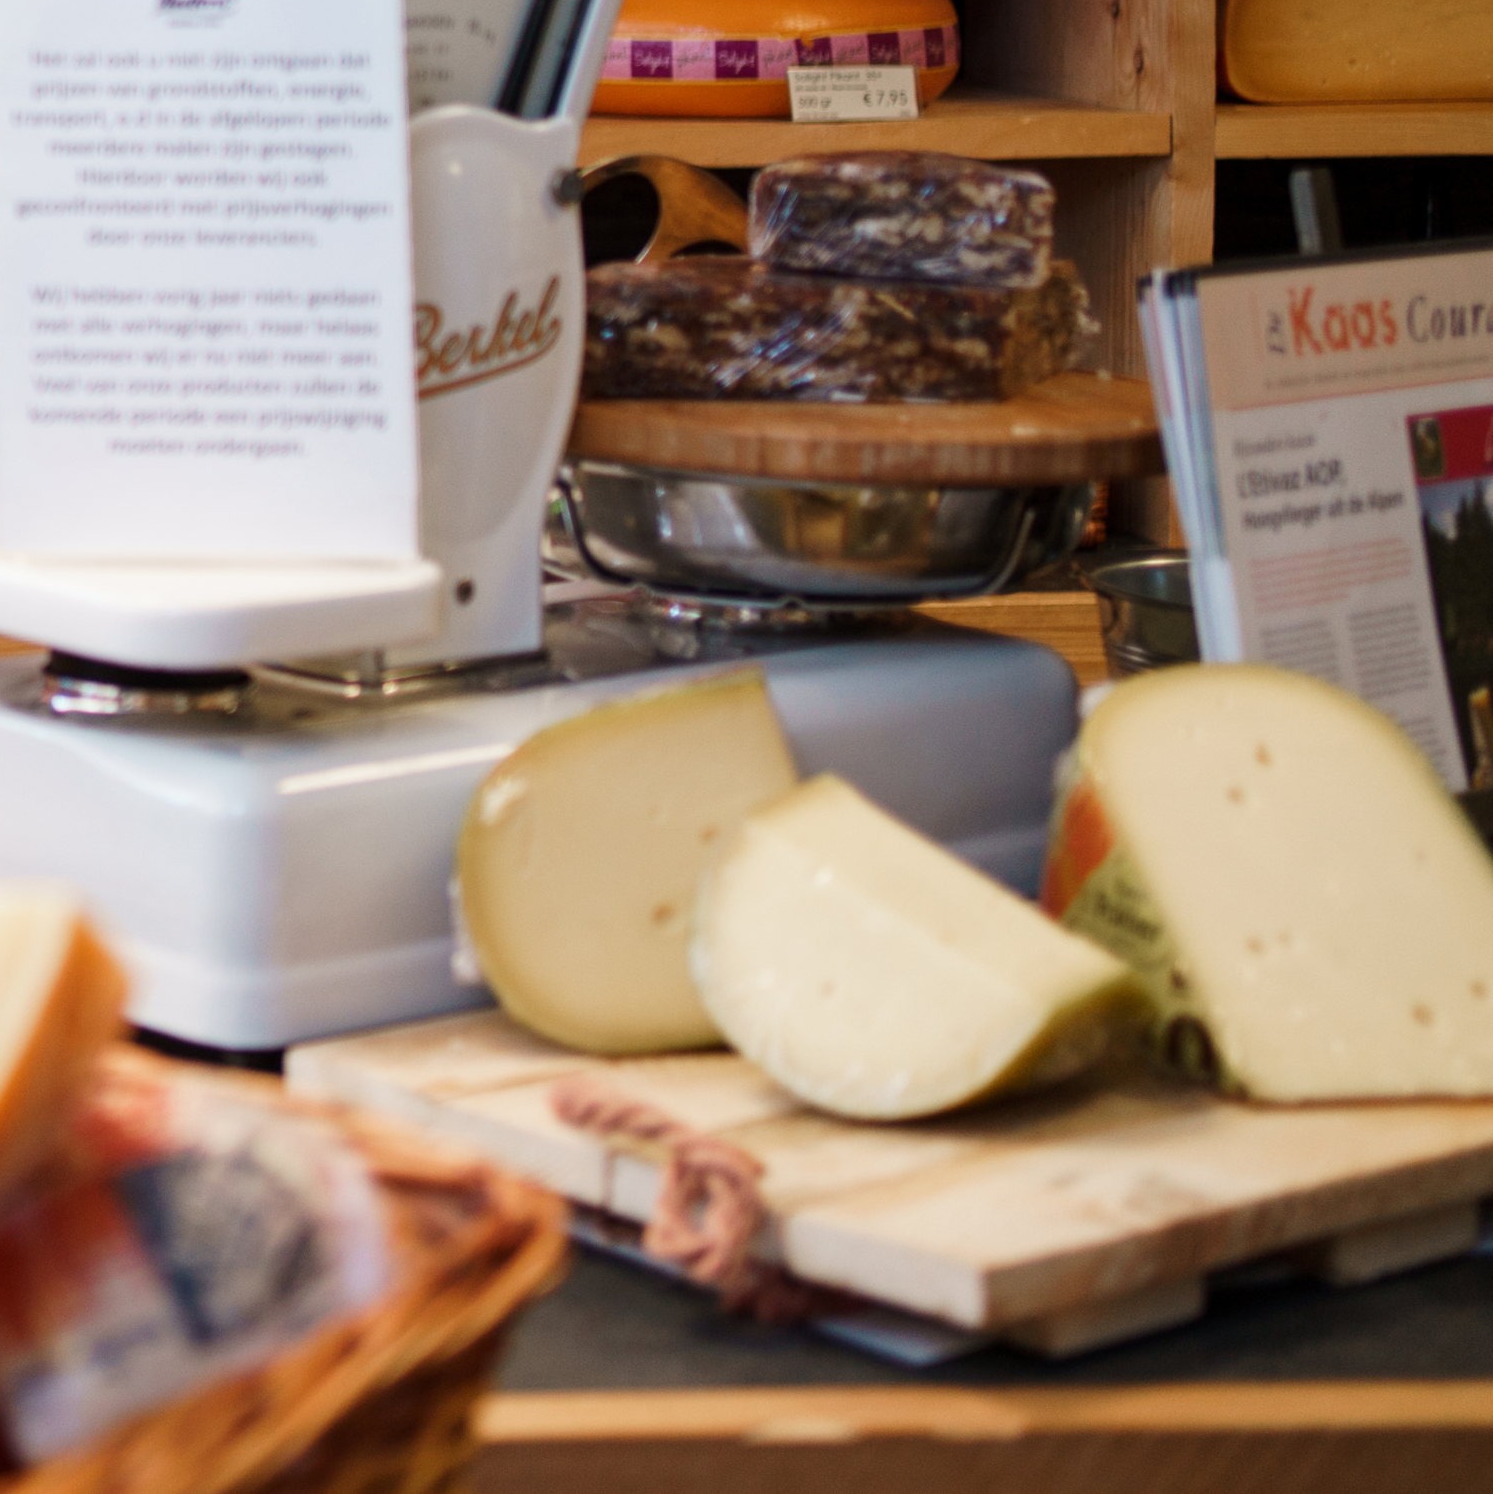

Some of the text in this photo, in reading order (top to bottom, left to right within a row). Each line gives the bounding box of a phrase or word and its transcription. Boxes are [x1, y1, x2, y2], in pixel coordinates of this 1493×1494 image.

[863, 92, 874, 107] €
[876, 89, 909, 108] 7,95
[414, 275, 561, 380] Berkel
[1286, 283, 1399, 358] Kaas
